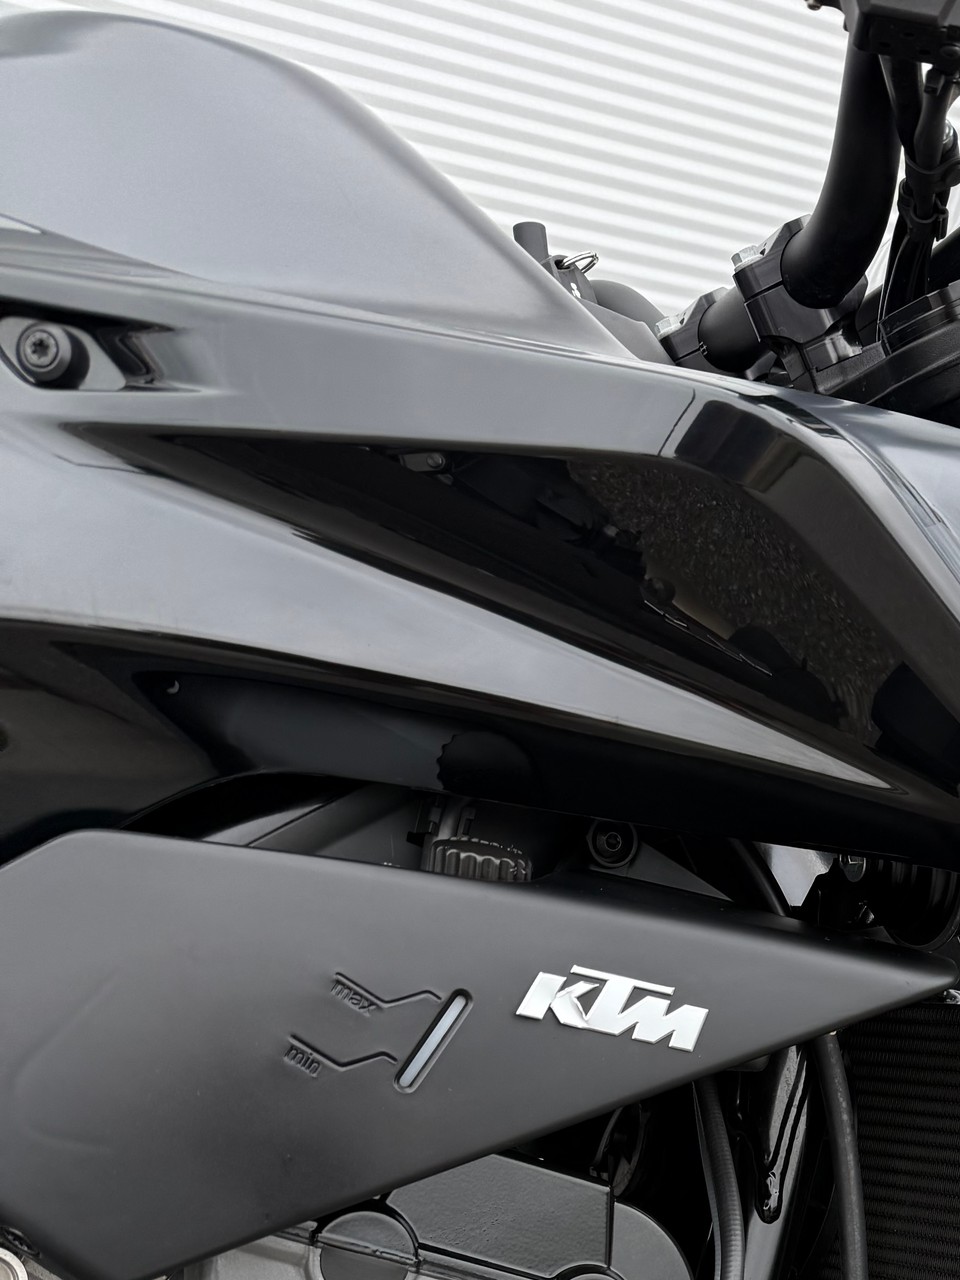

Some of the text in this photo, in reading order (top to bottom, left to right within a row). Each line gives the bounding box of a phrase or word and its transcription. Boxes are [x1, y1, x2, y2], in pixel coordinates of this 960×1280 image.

[329, 980, 378, 1017] max
[516, 965, 709, 1052] KTM
[283, 1046, 321, 1078] min
